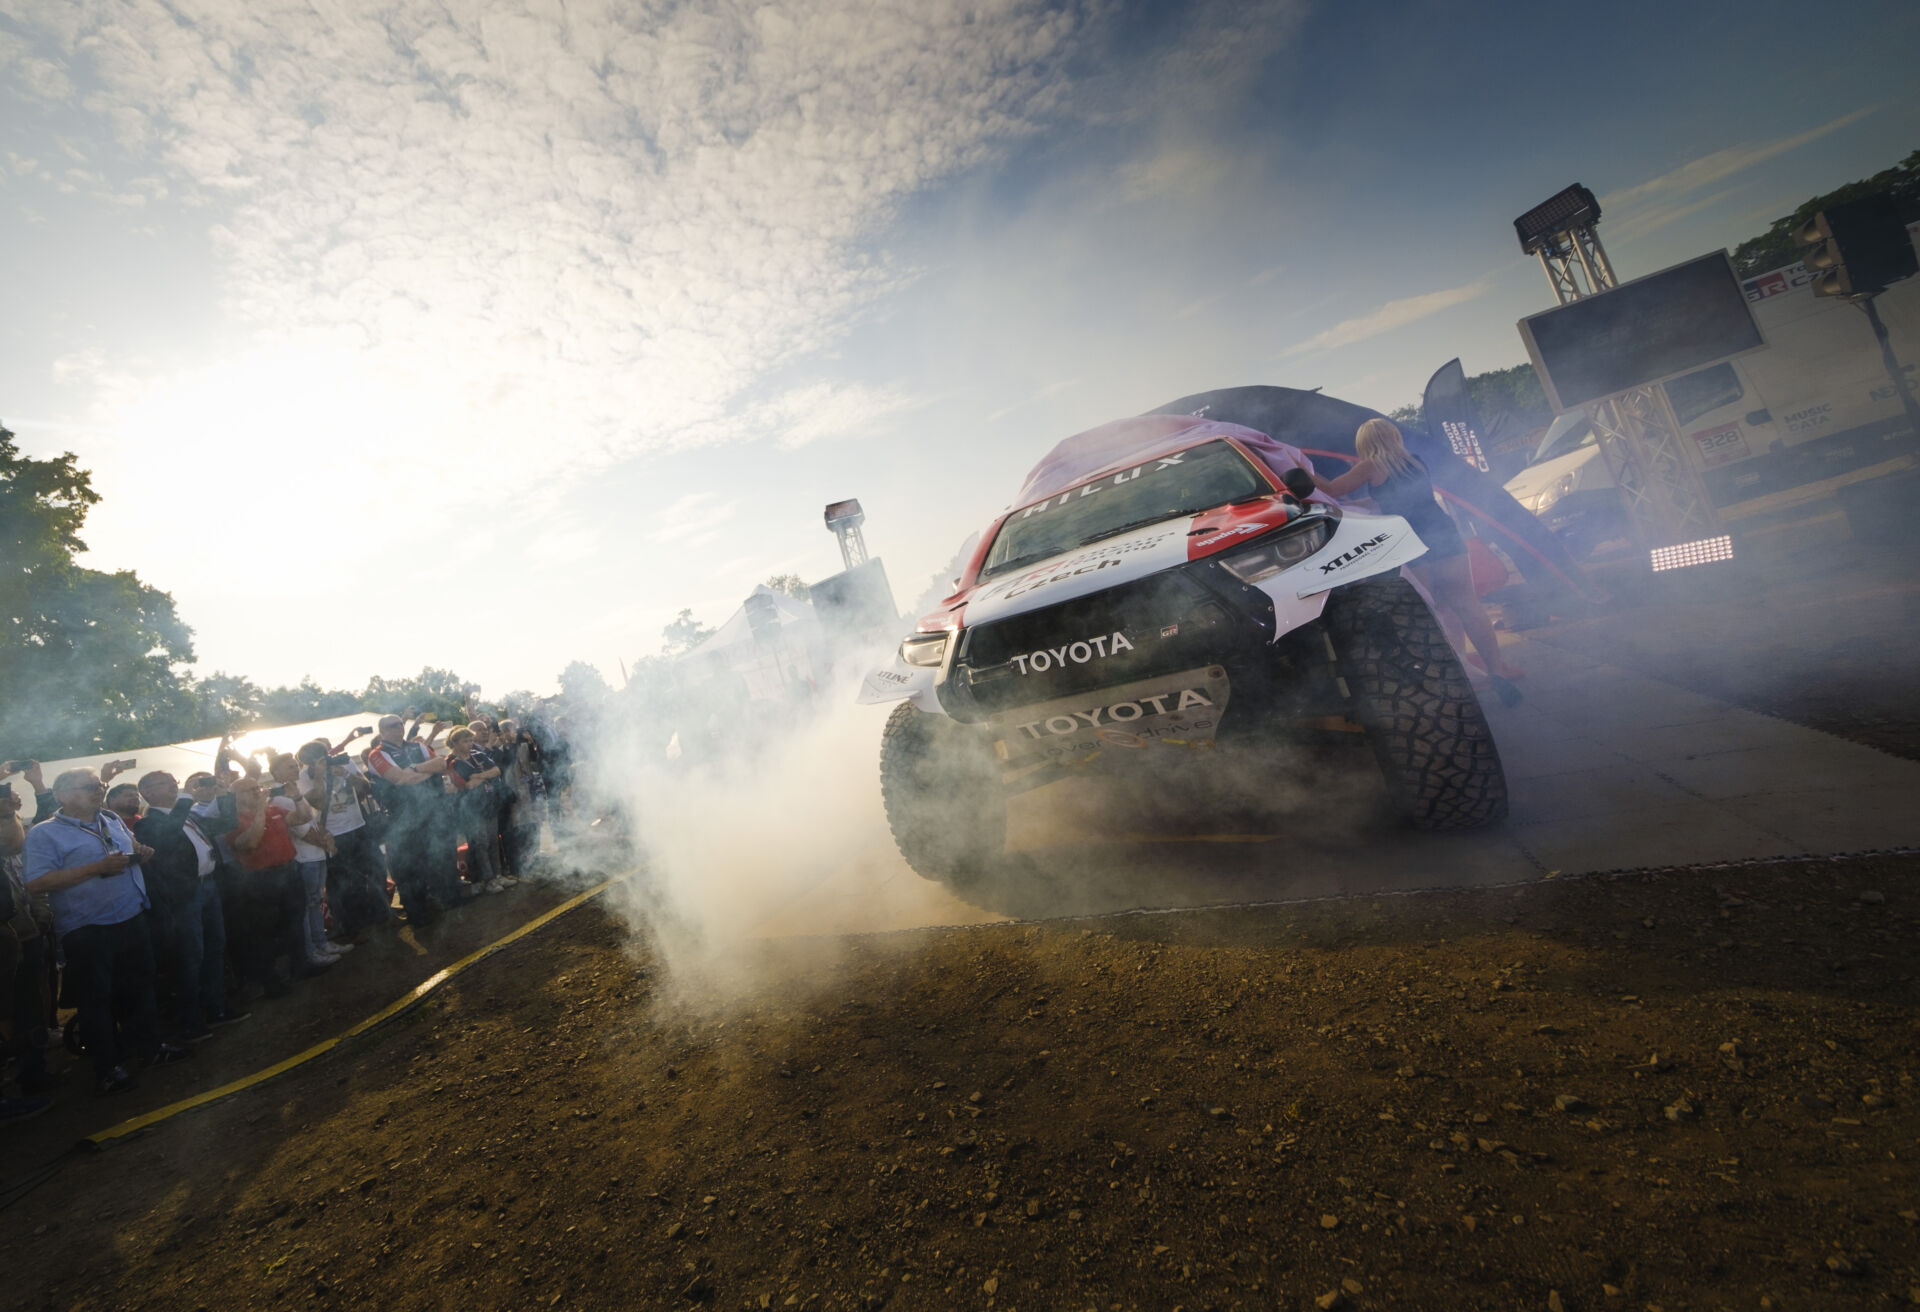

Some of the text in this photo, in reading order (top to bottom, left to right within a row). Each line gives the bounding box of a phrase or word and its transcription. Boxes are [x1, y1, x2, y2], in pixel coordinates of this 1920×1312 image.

[1784, 402, 1833, 424] MUSIC
[1788, 414, 1831, 433] DATA
[1701, 429, 1739, 451] 328
[1023, 452, 1186, 518] HILUX
[1196, 526, 1244, 547] agados
[1319, 532, 1393, 575] XTLINE
[1012, 631, 1135, 676] TOYOTA
[1016, 688, 1214, 740] TOYOTA
[1136, 718, 1213, 741] drive
